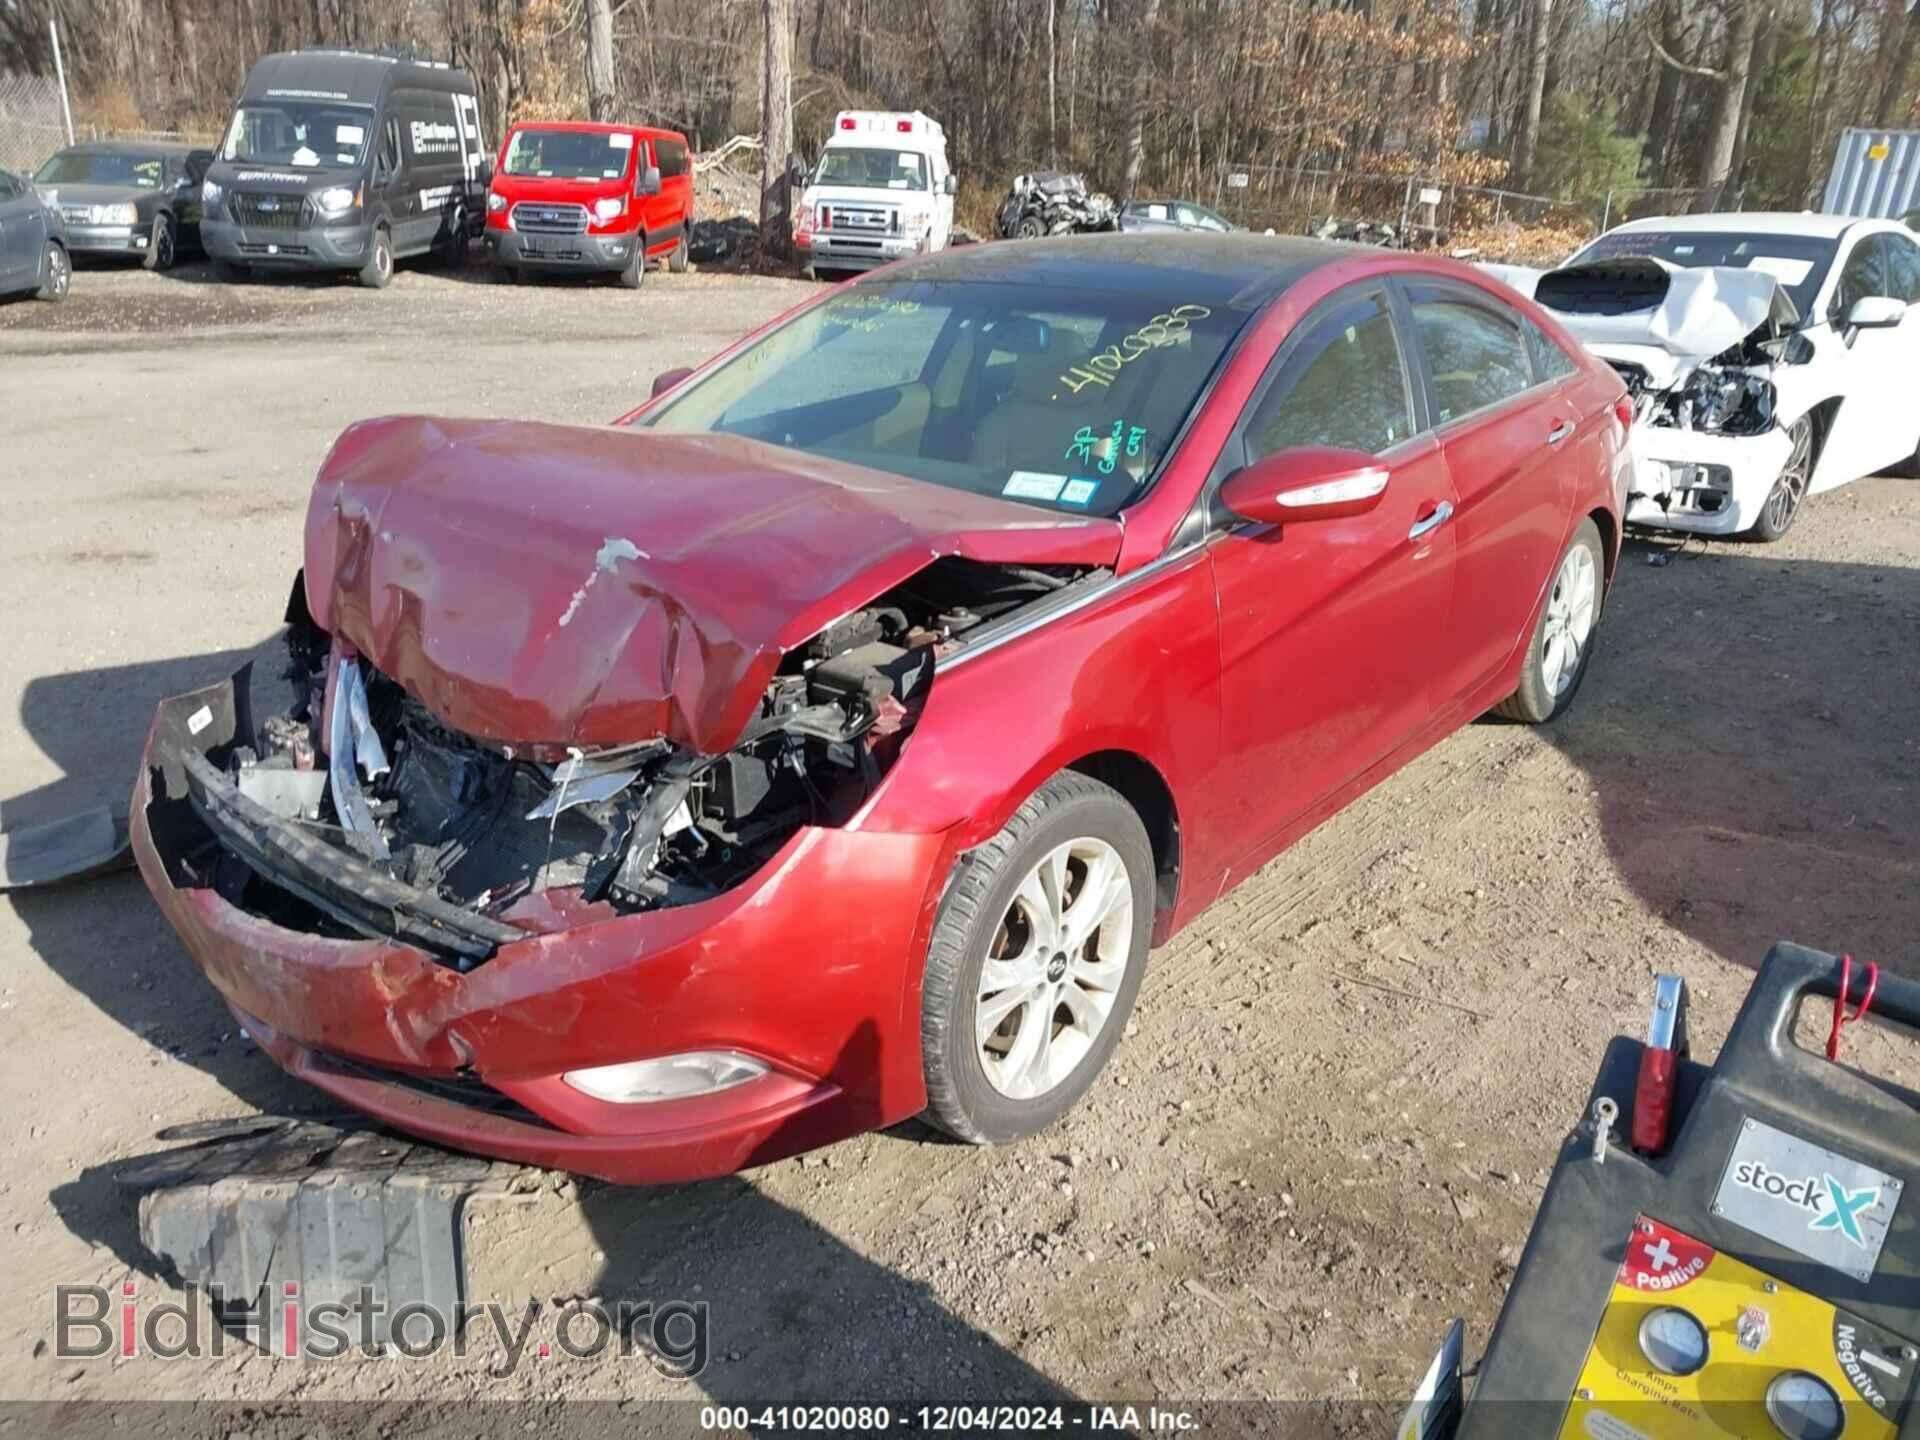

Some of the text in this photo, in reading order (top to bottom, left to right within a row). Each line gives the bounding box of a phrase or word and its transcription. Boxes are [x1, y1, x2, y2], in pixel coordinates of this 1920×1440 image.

[1636, 1257, 1705, 1290] Positive
[1645, 1370, 1679, 1394] Amps
[1837, 1323, 1886, 1409] Negative
[1616, 1369, 1671, 1405] Charging
